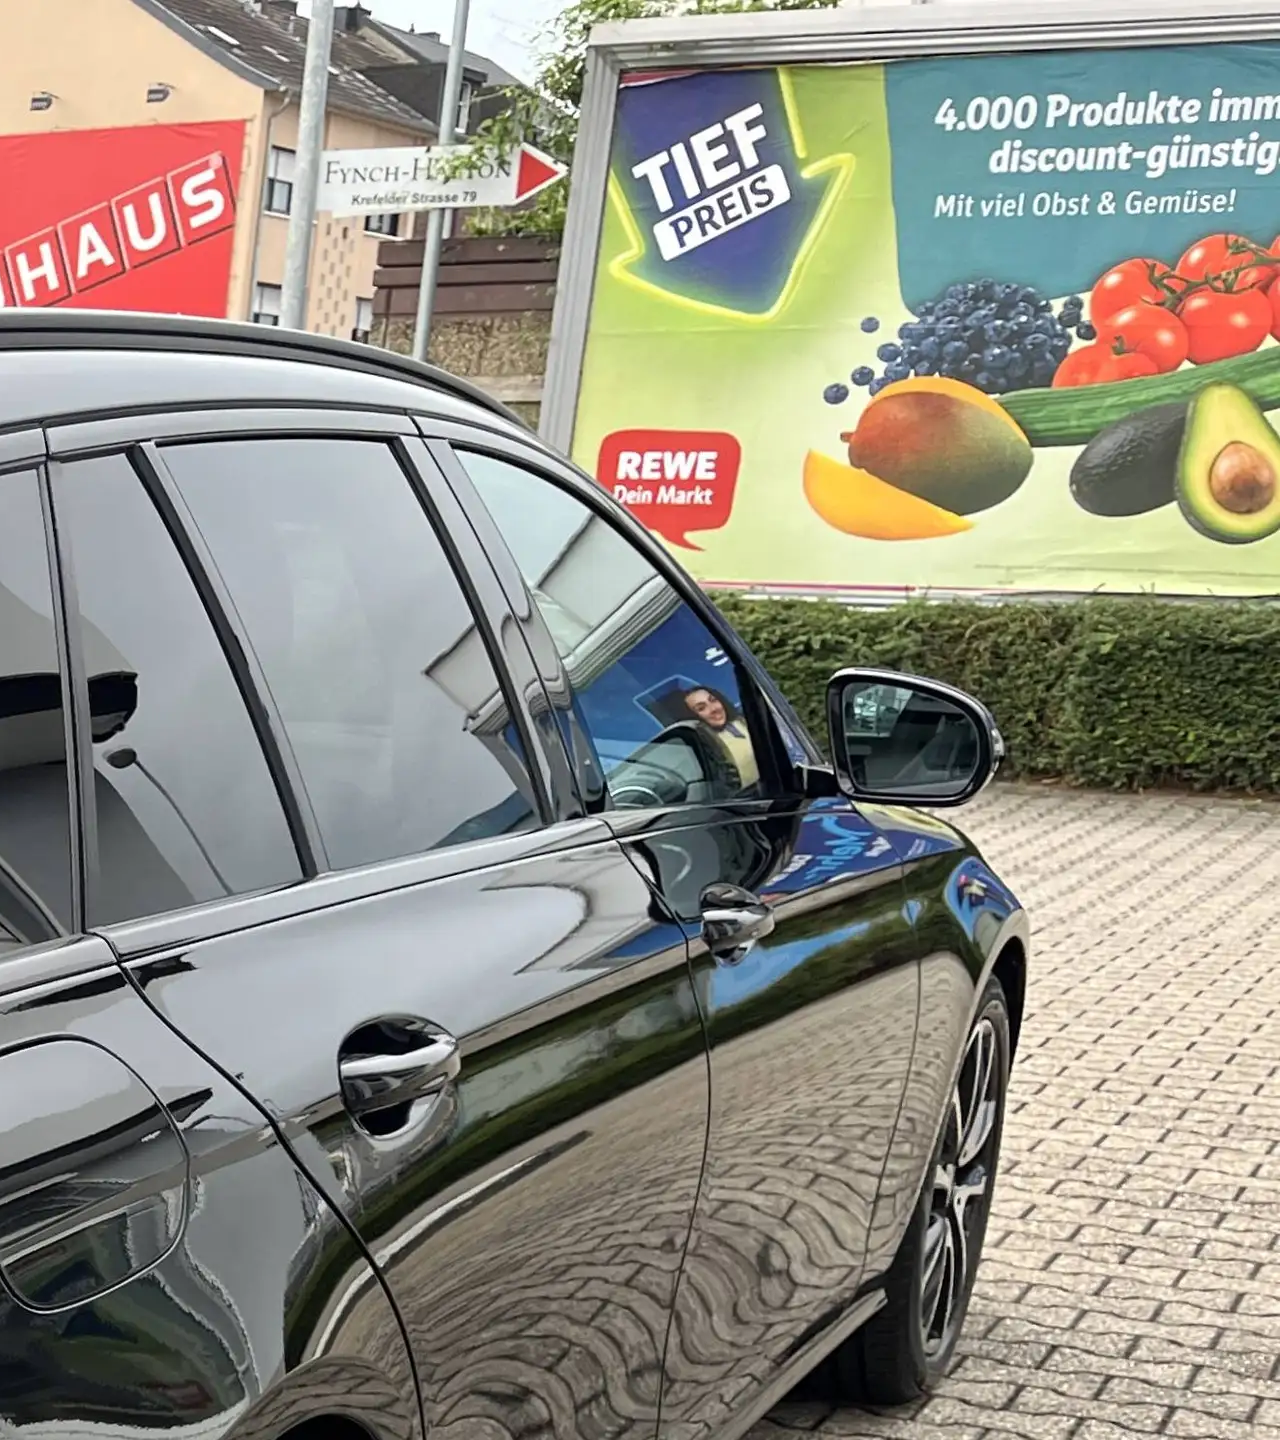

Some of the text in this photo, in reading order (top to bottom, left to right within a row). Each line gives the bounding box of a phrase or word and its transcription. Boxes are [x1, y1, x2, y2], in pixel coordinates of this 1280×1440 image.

[934, 96, 1038, 131] 4.000
[1045, 91, 1201, 128] Produkte
[631, 102, 767, 213] TIEF
[989, 131, 1280, 179] discount-günstig
[411, 191, 459, 204] Strasse
[462, 190, 477, 203] 79
[669, 174, 775, 249] PREIS
[933, 188, 1237, 218] Mit viel Obst & Gemüse!
[616, 450, 718, 480] REWE
[613, 484, 714, 505] Dein Markt
